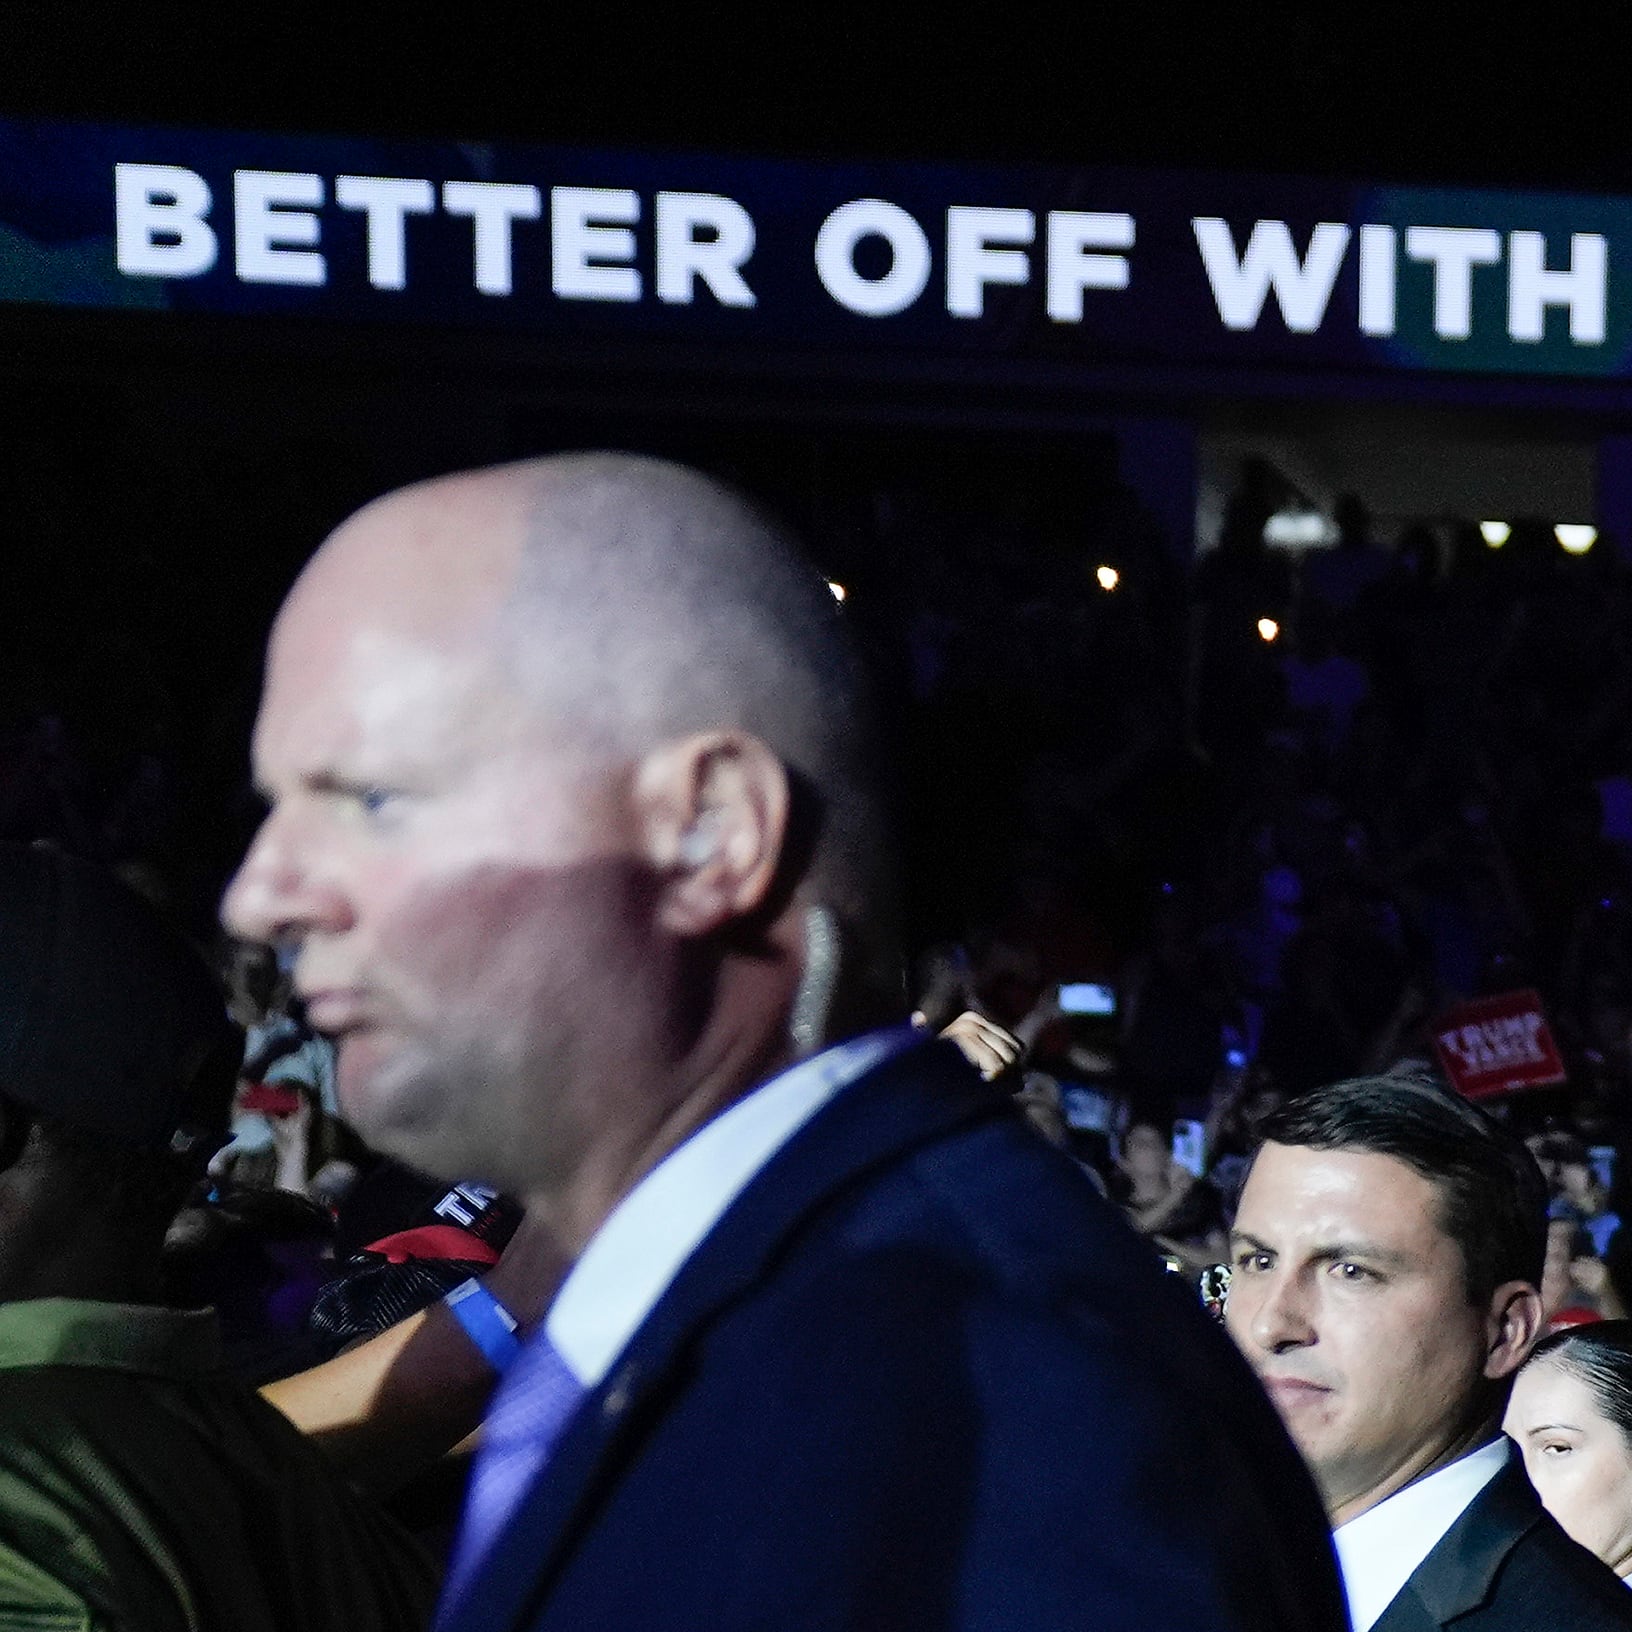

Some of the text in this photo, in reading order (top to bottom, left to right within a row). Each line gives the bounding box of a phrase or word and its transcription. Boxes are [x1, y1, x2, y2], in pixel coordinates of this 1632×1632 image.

[113, 161, 757, 308] BETTER
[813, 197, 1137, 323] OFF
[1191, 215, 1609, 345] WITH
